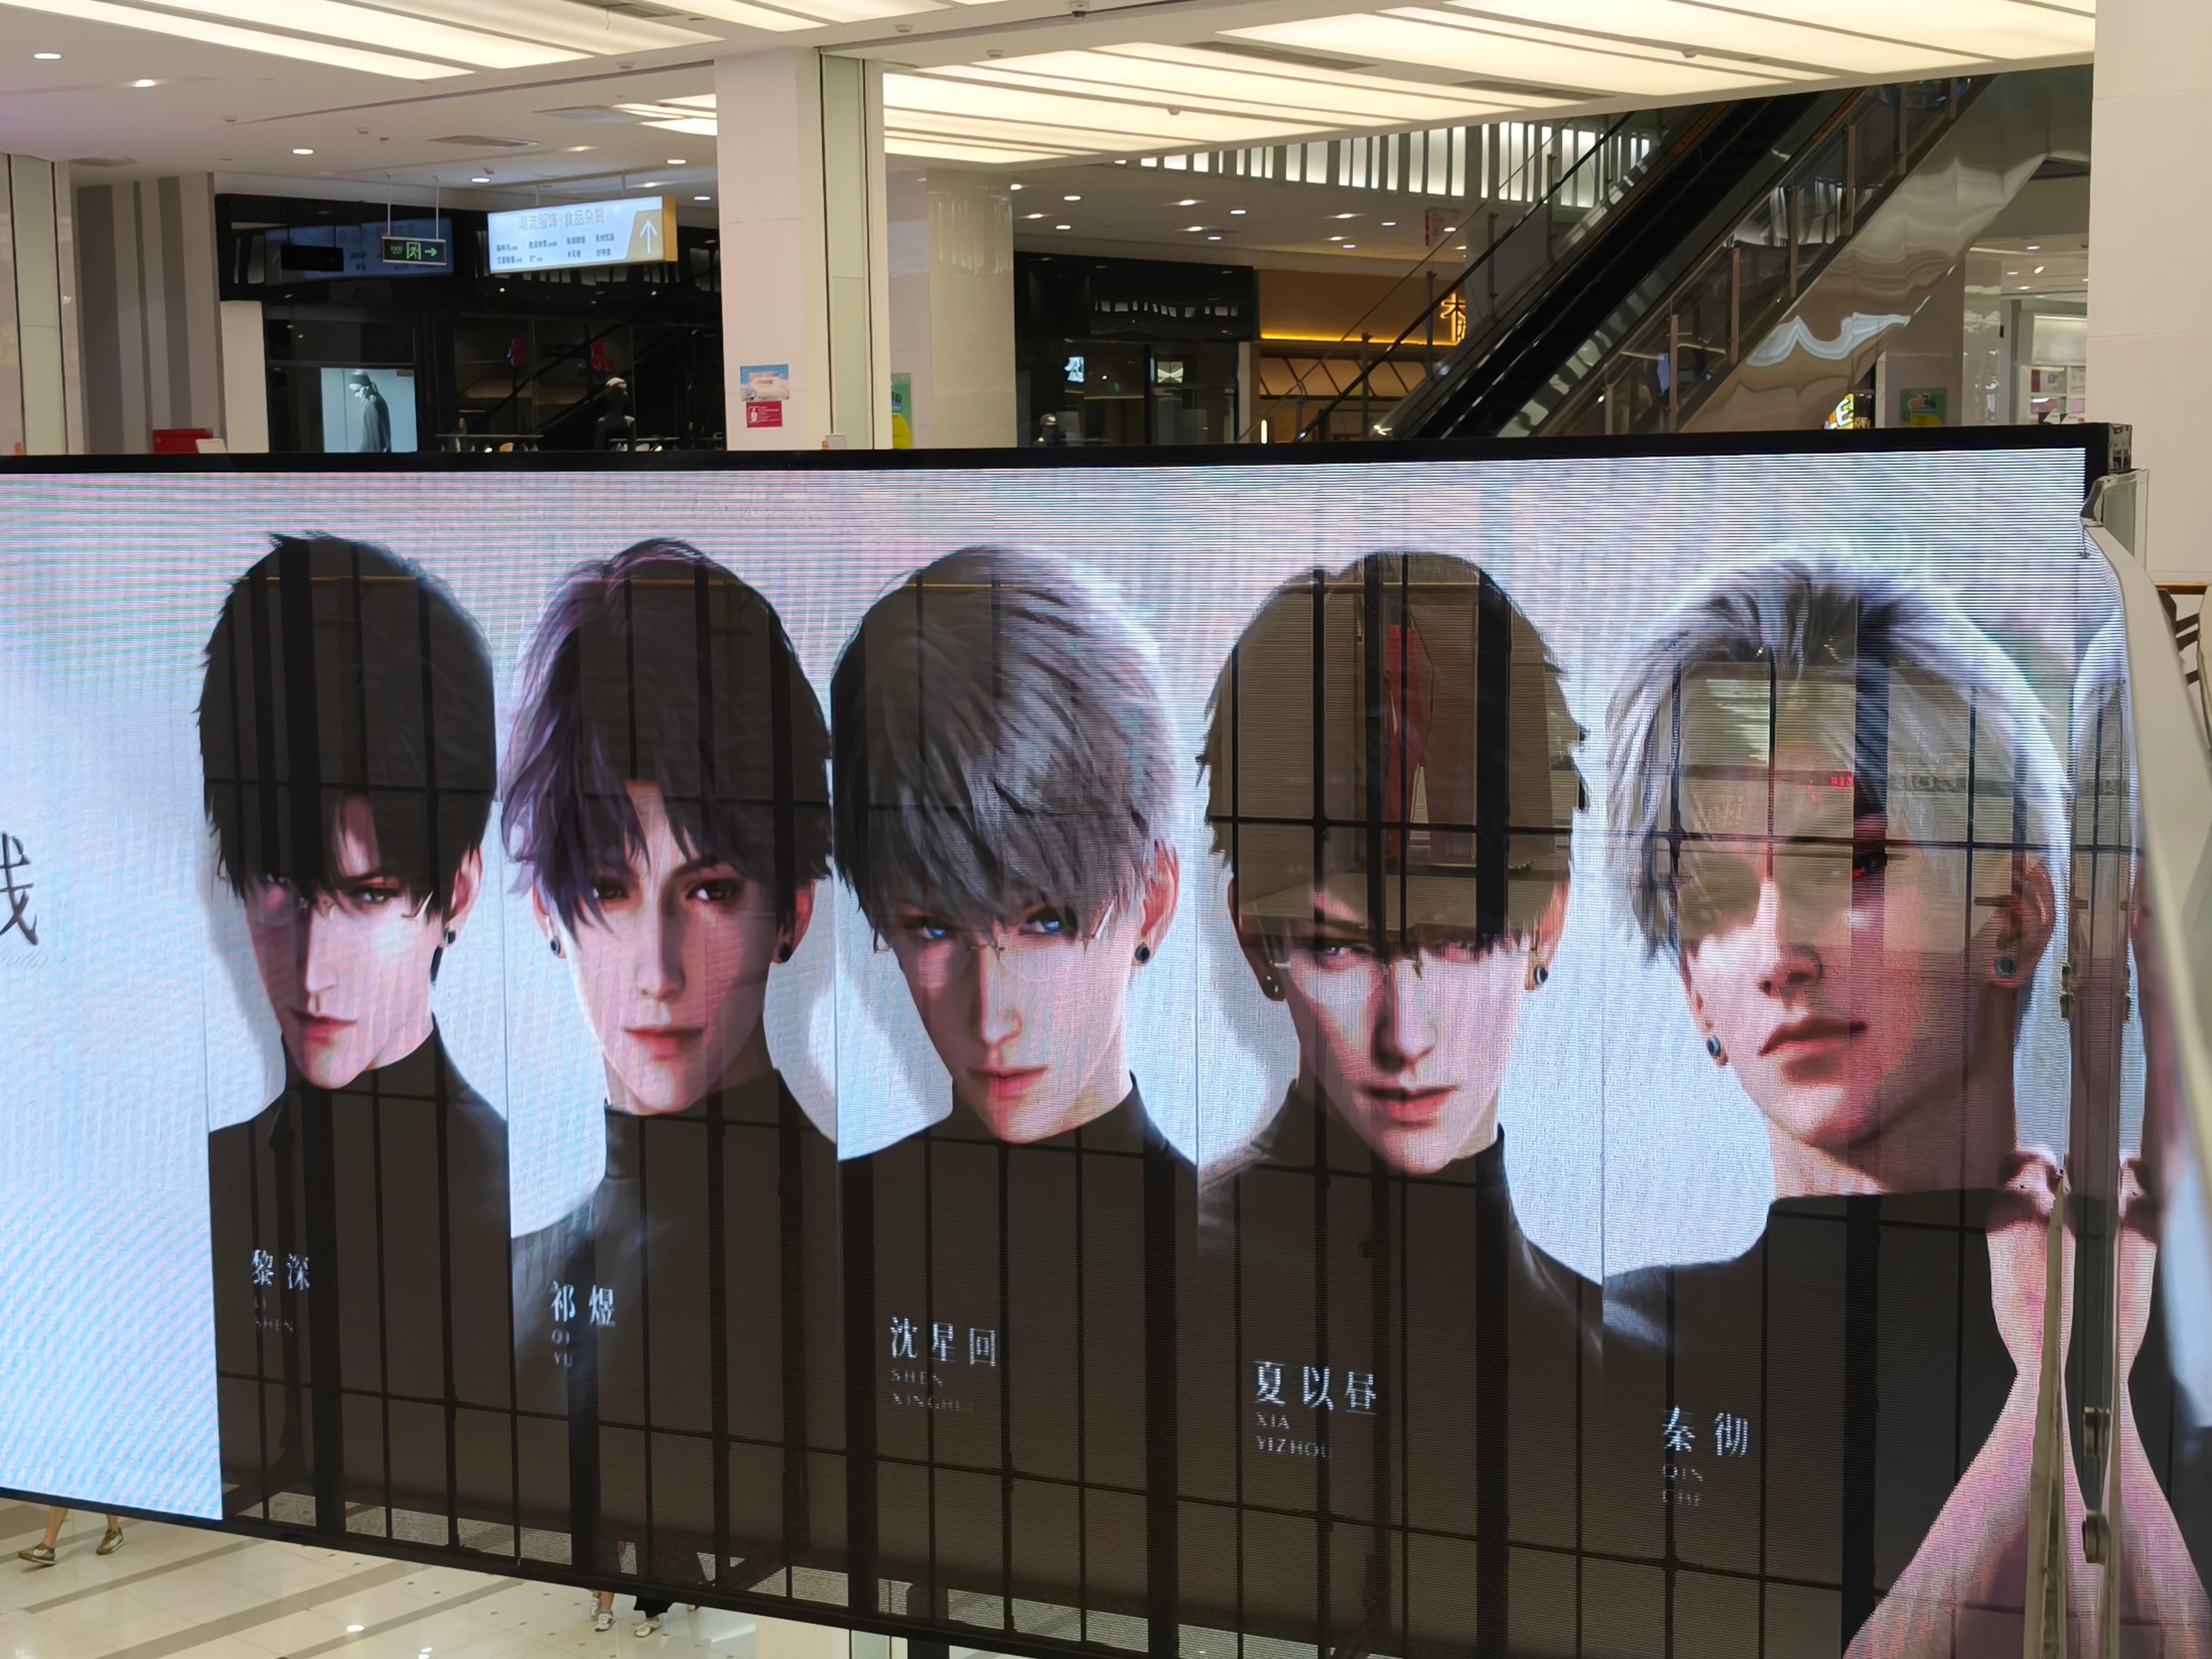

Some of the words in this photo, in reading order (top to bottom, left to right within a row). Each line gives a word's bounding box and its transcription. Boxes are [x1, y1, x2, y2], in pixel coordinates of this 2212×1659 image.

[563, 207, 605, 228] 食品杂货
[251, 1250, 311, 1291] 黎深
[549, 1280, 616, 1328] 祁煜
[890, 1316, 996, 1367] 沈星回
[1255, 1360, 1378, 1415] 夏以昼
[1256, 1412, 1290, 1429] XIA
[1662, 1405, 1749, 1458] 秦彻
